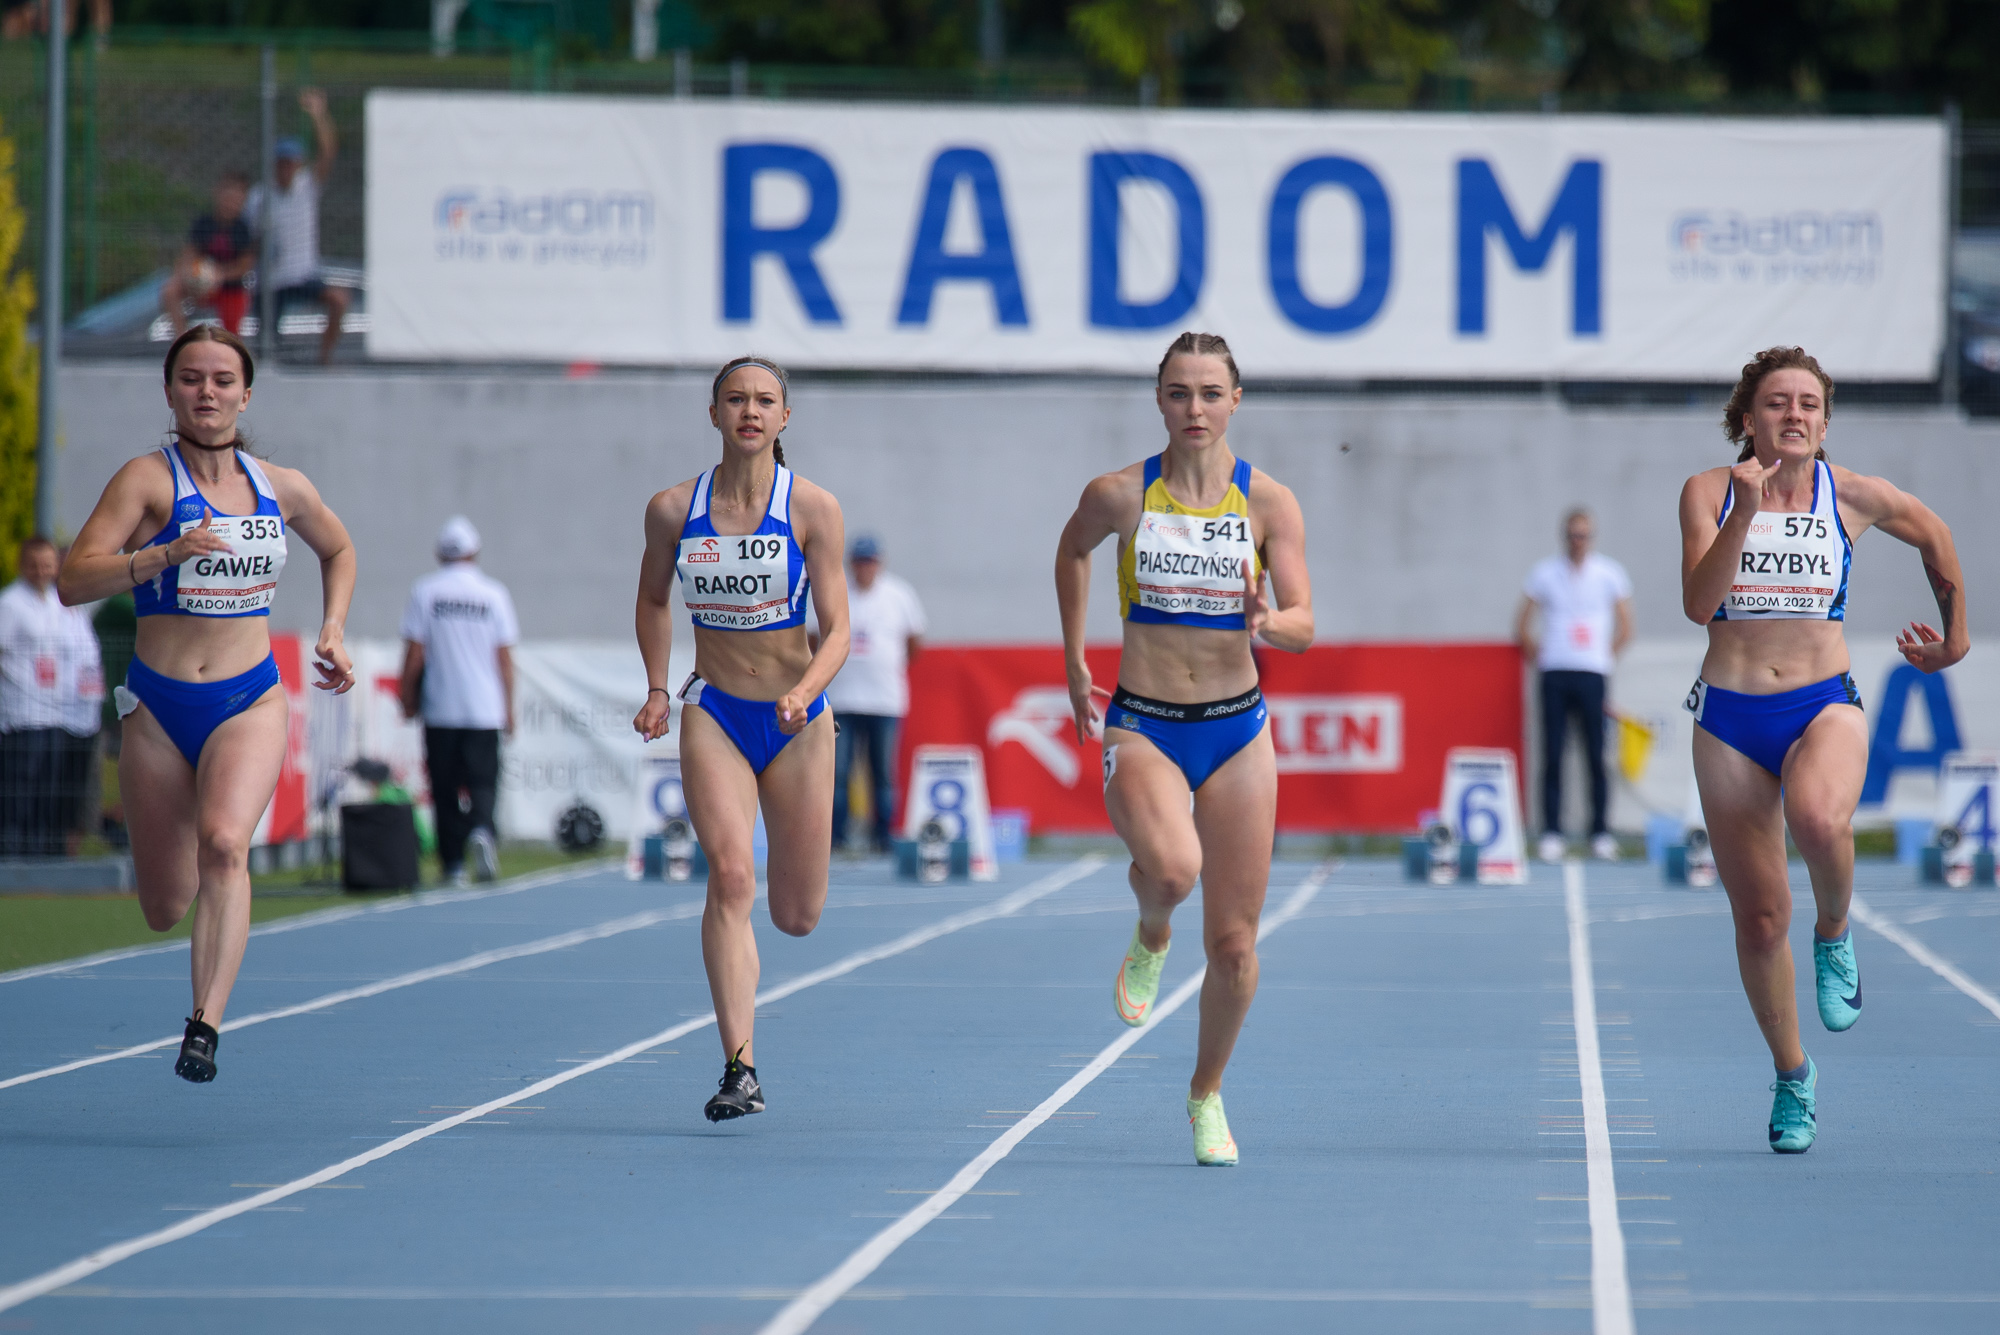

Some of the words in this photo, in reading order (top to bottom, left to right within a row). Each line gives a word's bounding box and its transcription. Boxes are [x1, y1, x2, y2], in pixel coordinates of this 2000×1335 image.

[435, 186, 655, 234] radom
[720, 138, 1607, 340] RADOM
[241, 519, 279, 540] 353
[1159, 525, 1191, 537] mosir
[1202, 521, 1248, 542] 541
[1785, 517, 1827, 539] 575
[689, 553, 719, 562] ORLEN
[738, 539, 781, 560] 109
[195, 555, 273, 578] GAWEŁ
[1741, 552, 1831, 576] RZYBYŁ
[694, 574, 771, 595] RAROT
[187, 599, 236, 609] RADOM
[240, 595, 259, 608] 2022
[1147, 595, 1191, 608] RADOM
[1196, 598, 1226, 610] 2022
[1731, 596, 1780, 607] RADOM
[1784, 597, 1814, 608] 2022
[695, 612, 737, 625] RADOM
[740, 613, 769, 625] 2022
[1686, 679, 1702, 712] 5
[1270, 713, 1381, 757] LEN
[1856, 664, 1963, 808] A
[930, 779, 968, 843] 8
[1459, 783, 1500, 848] 6
[1955, 783, 2000, 853] 4
